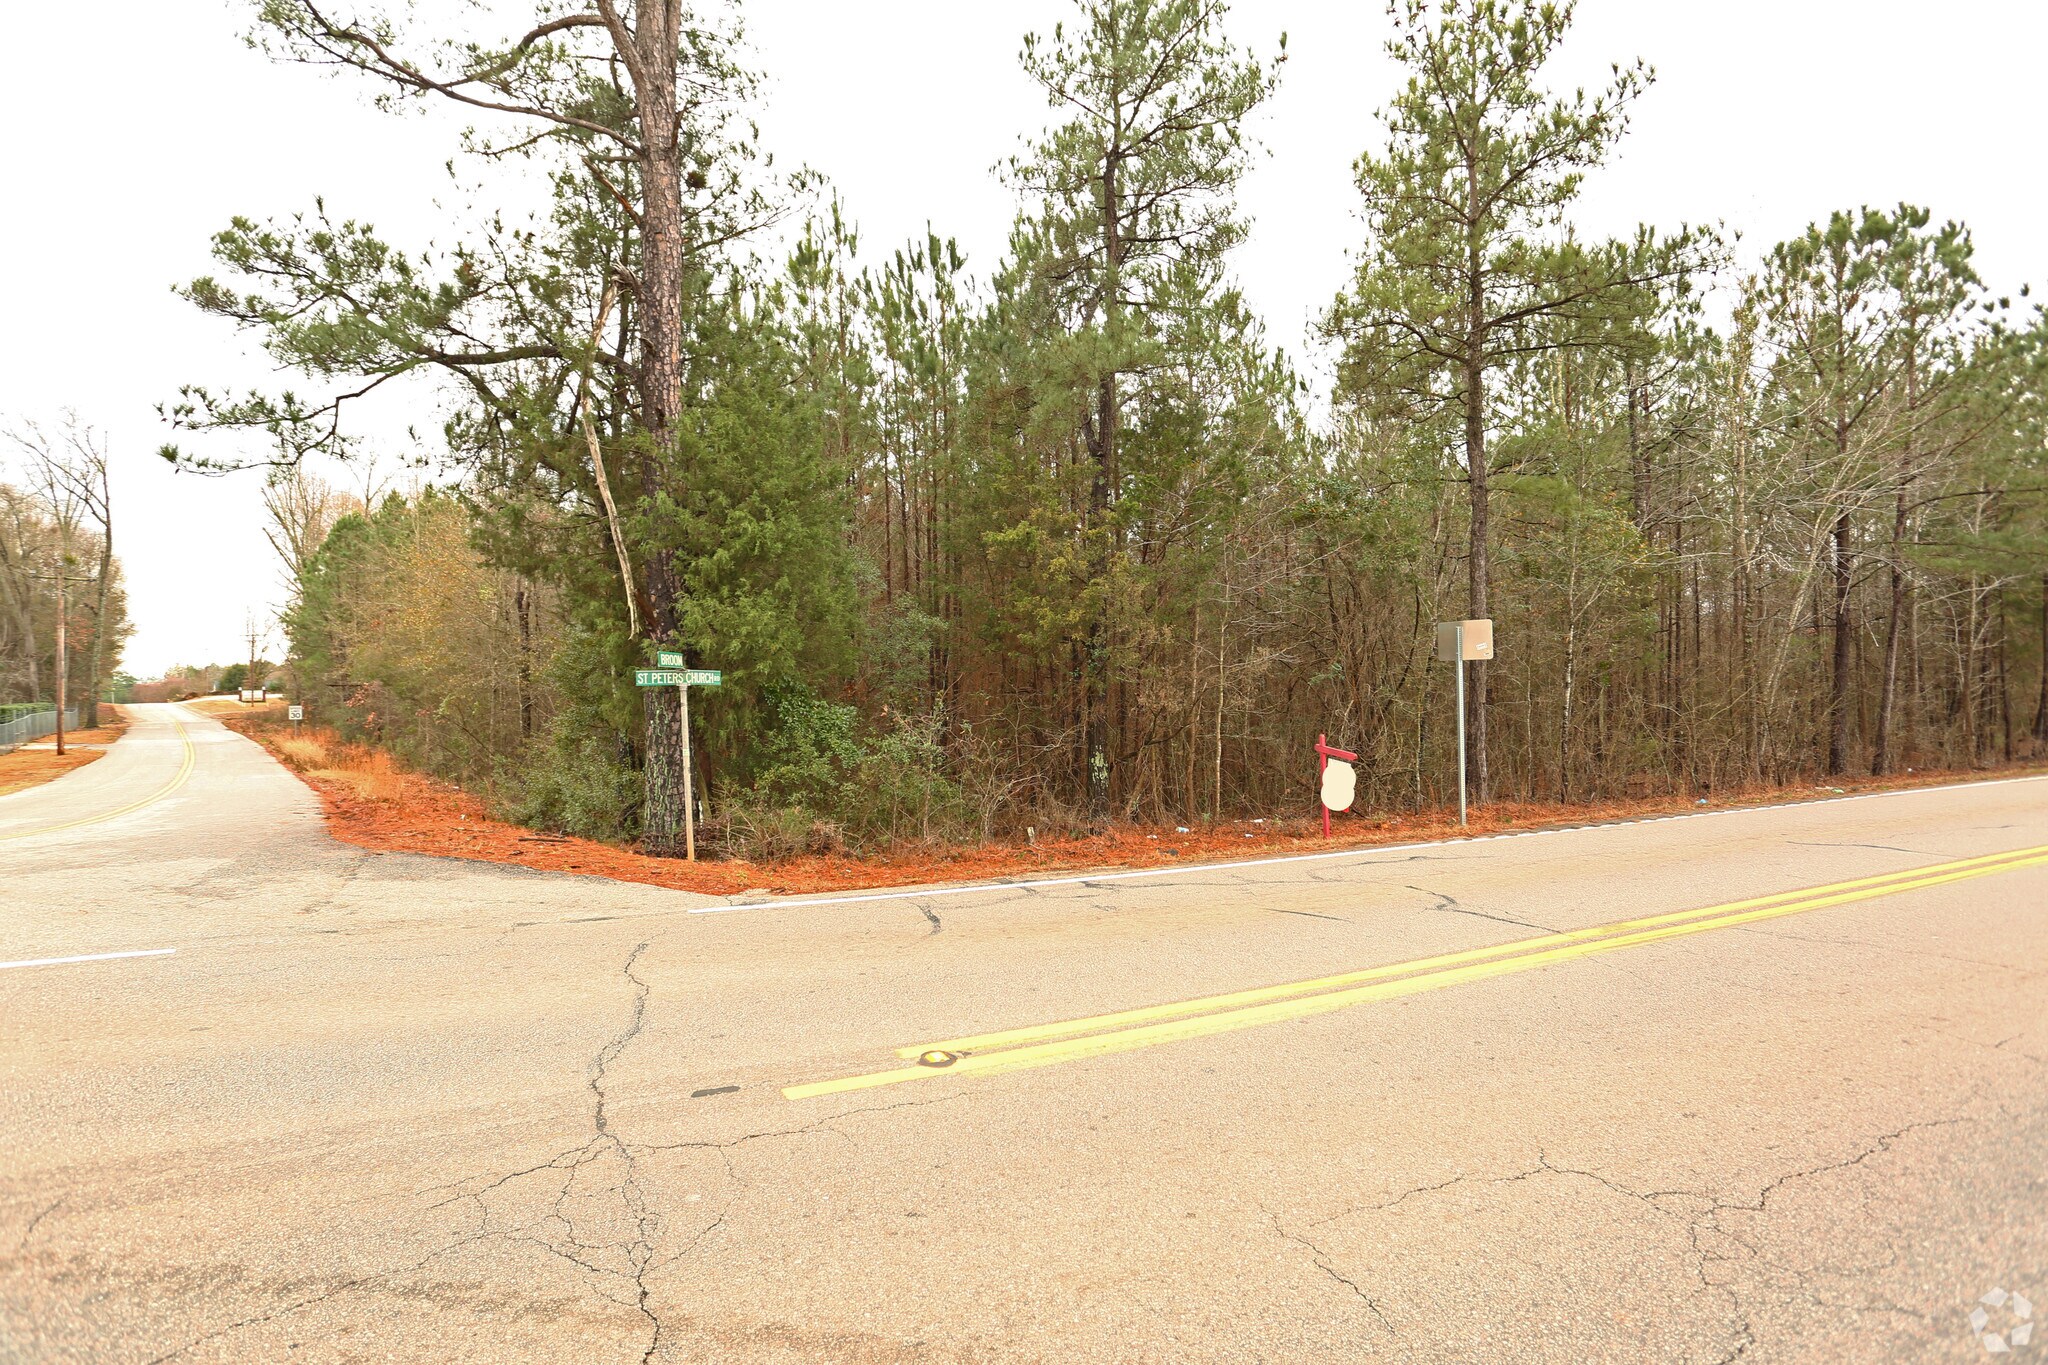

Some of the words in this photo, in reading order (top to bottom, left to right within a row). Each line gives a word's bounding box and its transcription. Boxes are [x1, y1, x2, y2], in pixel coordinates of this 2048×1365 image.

[637, 673, 649, 684] ST
[651, 673, 684, 684] PETERS
[686, 673, 714, 684] CHURCH
